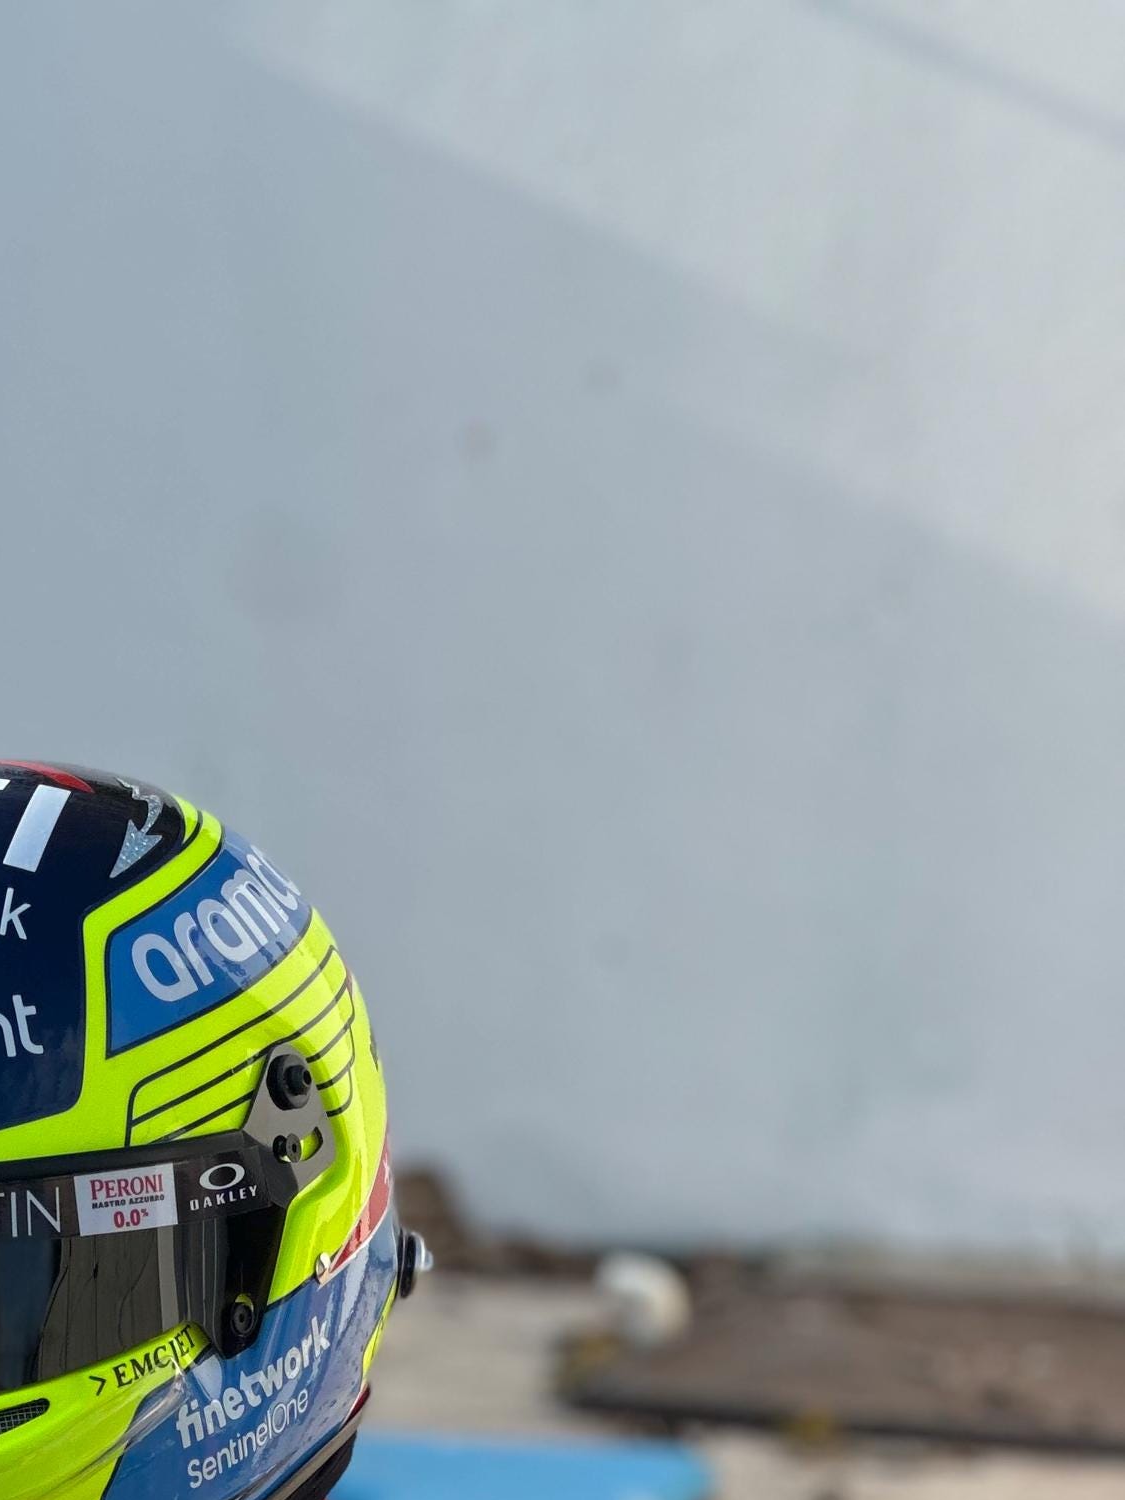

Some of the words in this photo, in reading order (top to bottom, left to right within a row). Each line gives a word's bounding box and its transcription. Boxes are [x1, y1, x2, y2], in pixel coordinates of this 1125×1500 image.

[89, 1174, 164, 1201] PERONI
[189, 1185, 259, 1212] OAKLEY
[113, 1208, 149, 1228] 0.0%
[113, 1325, 196, 1389] EMCJET
[176, 1316, 332, 1449] finetwork
[187, 1389, 310, 1489] SentinelOne
